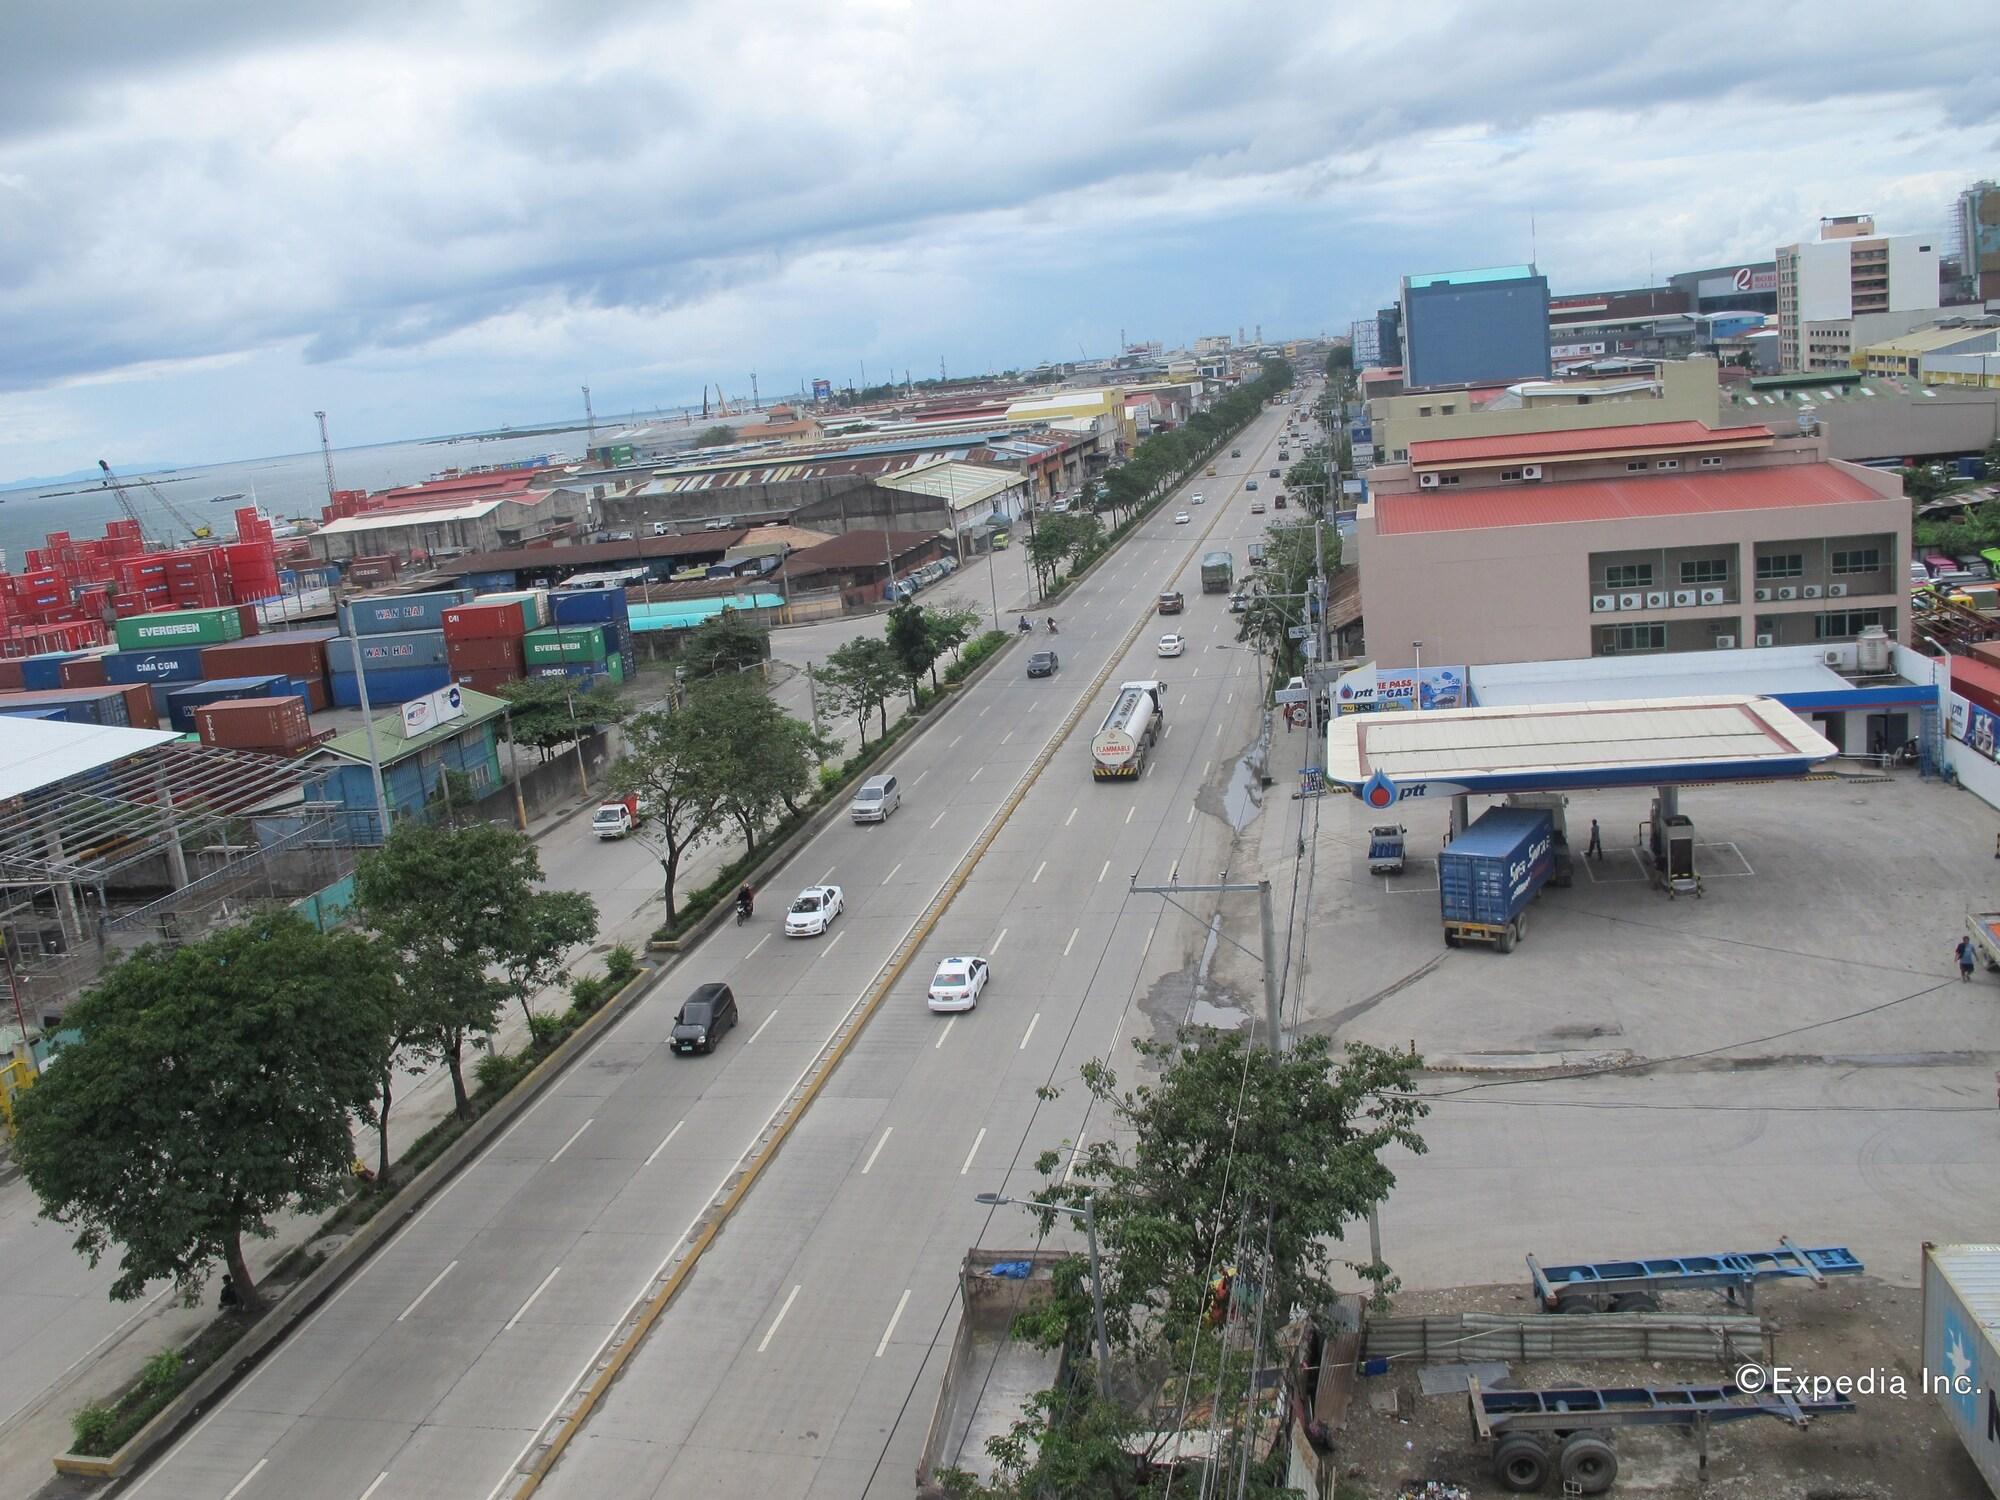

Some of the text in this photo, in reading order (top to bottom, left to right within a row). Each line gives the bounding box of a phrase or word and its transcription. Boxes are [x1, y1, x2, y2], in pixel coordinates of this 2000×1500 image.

[375, 605, 424, 619] WAN HAI
[138, 623, 200, 637] EVERGREEN
[364, 644, 413, 657] WAN HAI
[137, 661, 178, 672] CMA CGM
[1389, 679, 1412, 688] PASS
[1354, 688, 1373, 699] ptt
[1386, 687, 1413, 698] GAS!
[1399, 784, 1427, 800] ptt
